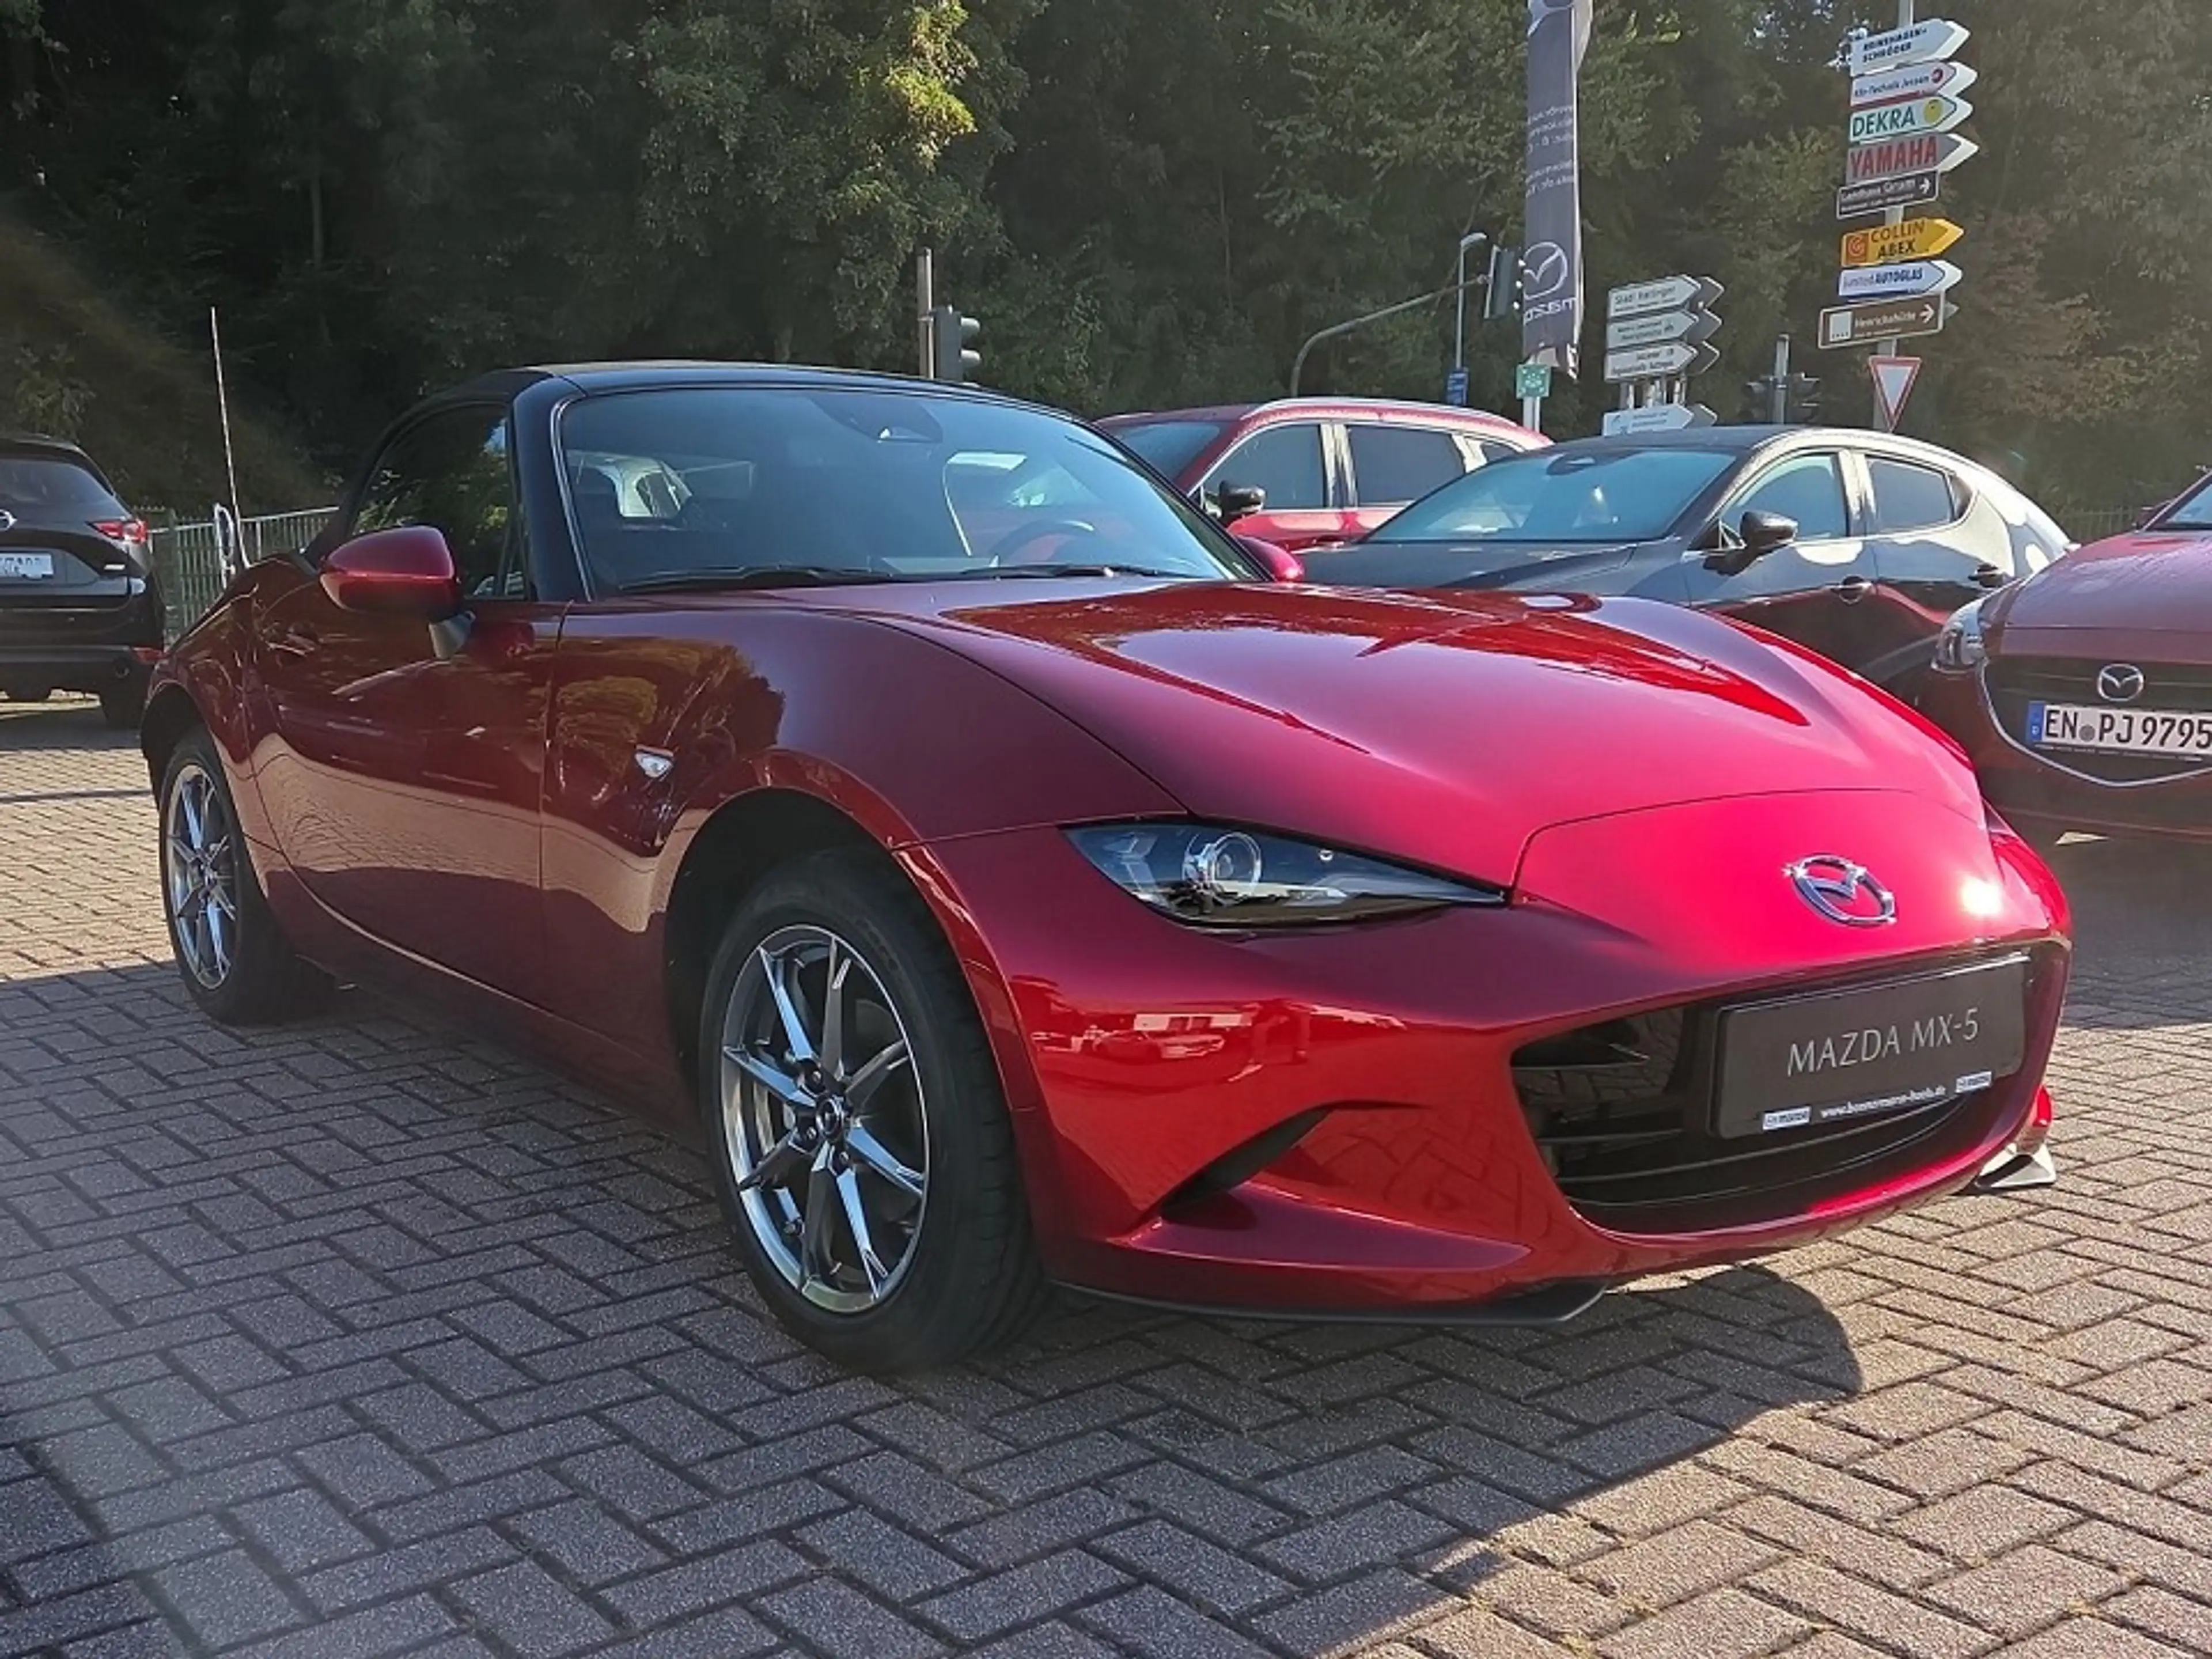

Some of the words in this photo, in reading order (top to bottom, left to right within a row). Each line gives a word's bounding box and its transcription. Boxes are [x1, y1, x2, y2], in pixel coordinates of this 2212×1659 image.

[1853, 105, 1916, 137] DEKRA
[1850, 135, 1937, 178] YAMAHA
[1871, 219, 1925, 243] COLLIN
[2046, 709, 2078, 738] EN
[2099, 714, 2134, 743] PJ
[2141, 716, 2212, 748] 9795
[1787, 1025, 1901, 1077] MAZDA
[1910, 1007, 1978, 1052] MX-5
